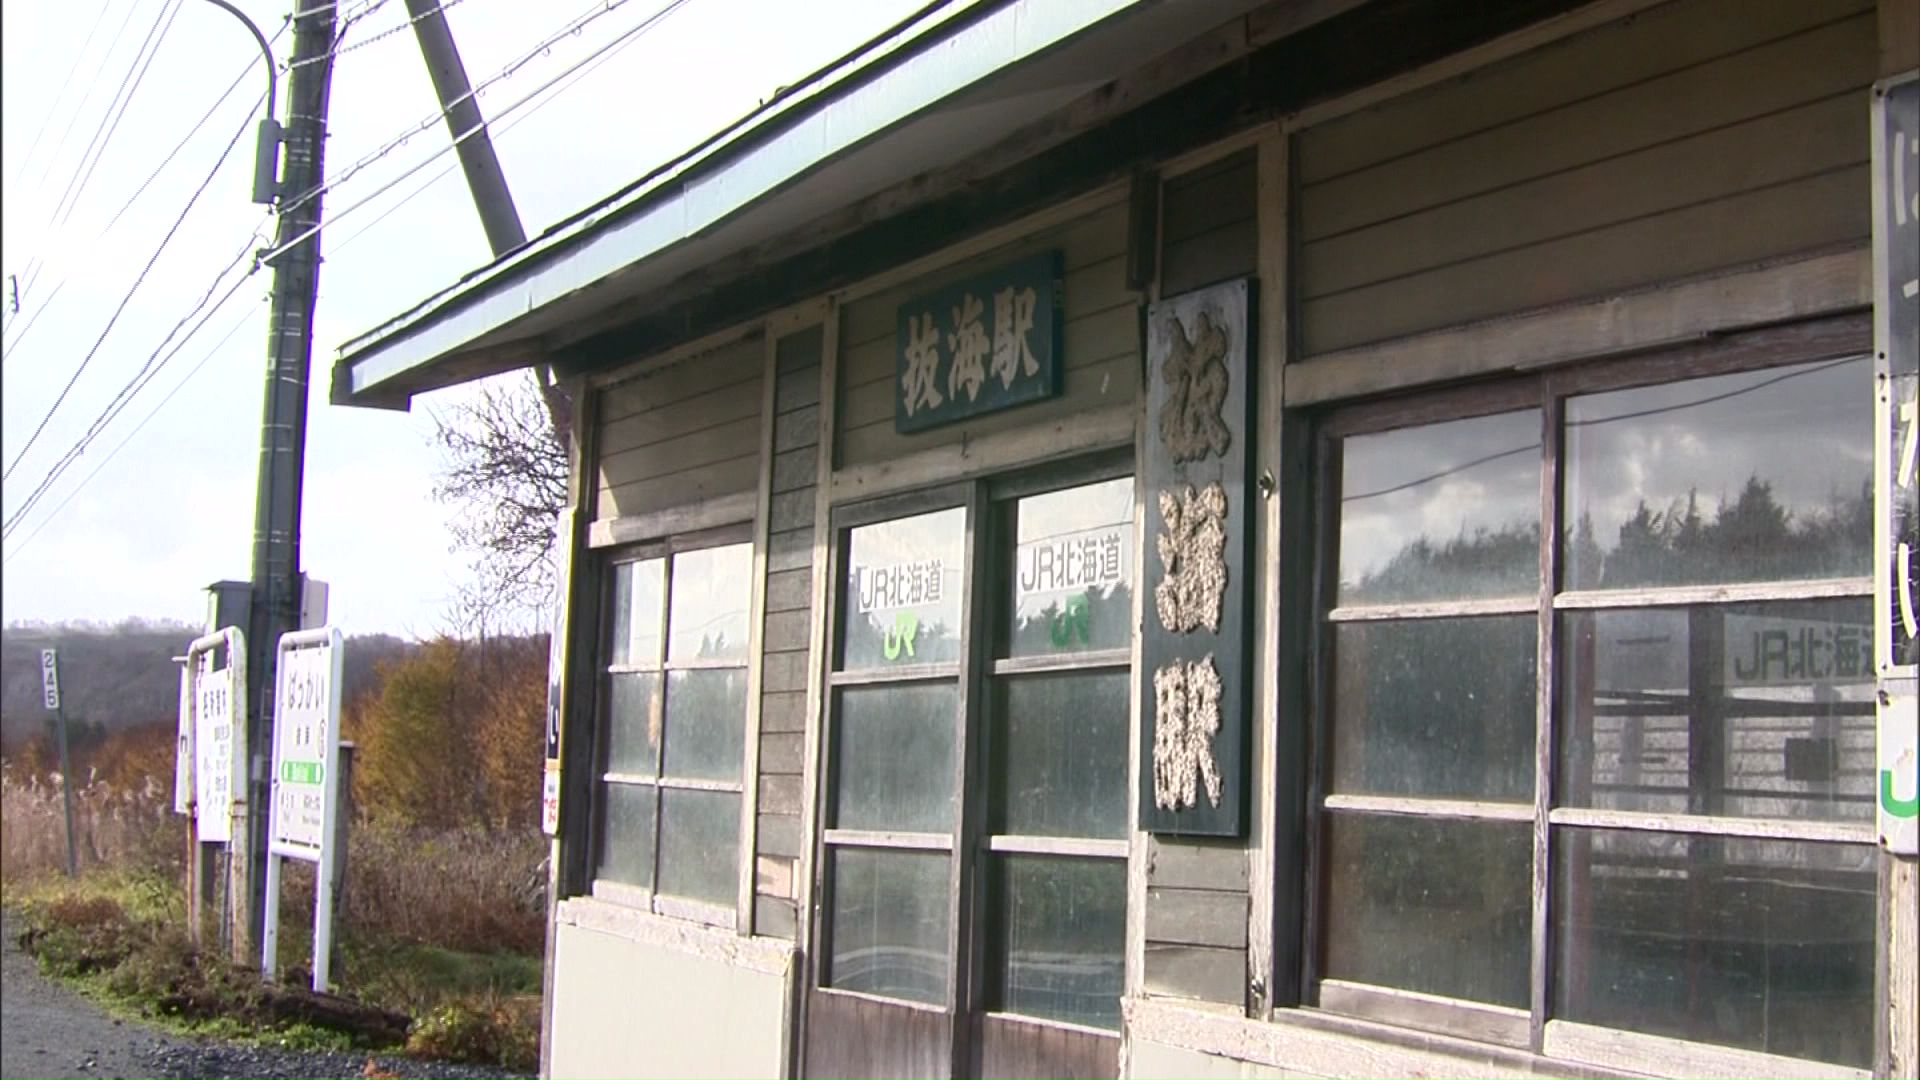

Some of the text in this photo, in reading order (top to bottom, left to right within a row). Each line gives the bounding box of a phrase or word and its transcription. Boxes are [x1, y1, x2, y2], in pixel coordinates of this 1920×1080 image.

[902, 287, 1039, 417] 抜海駅
[862, 562, 942, 608] JR北海道
[1022, 533, 1120, 590] JR北海道
[1153, 311, 1231, 812] 抜海駅
[885, 610, 918, 660] JR
[1049, 593, 1089, 649] JR
[44, 652, 56, 706] 245
